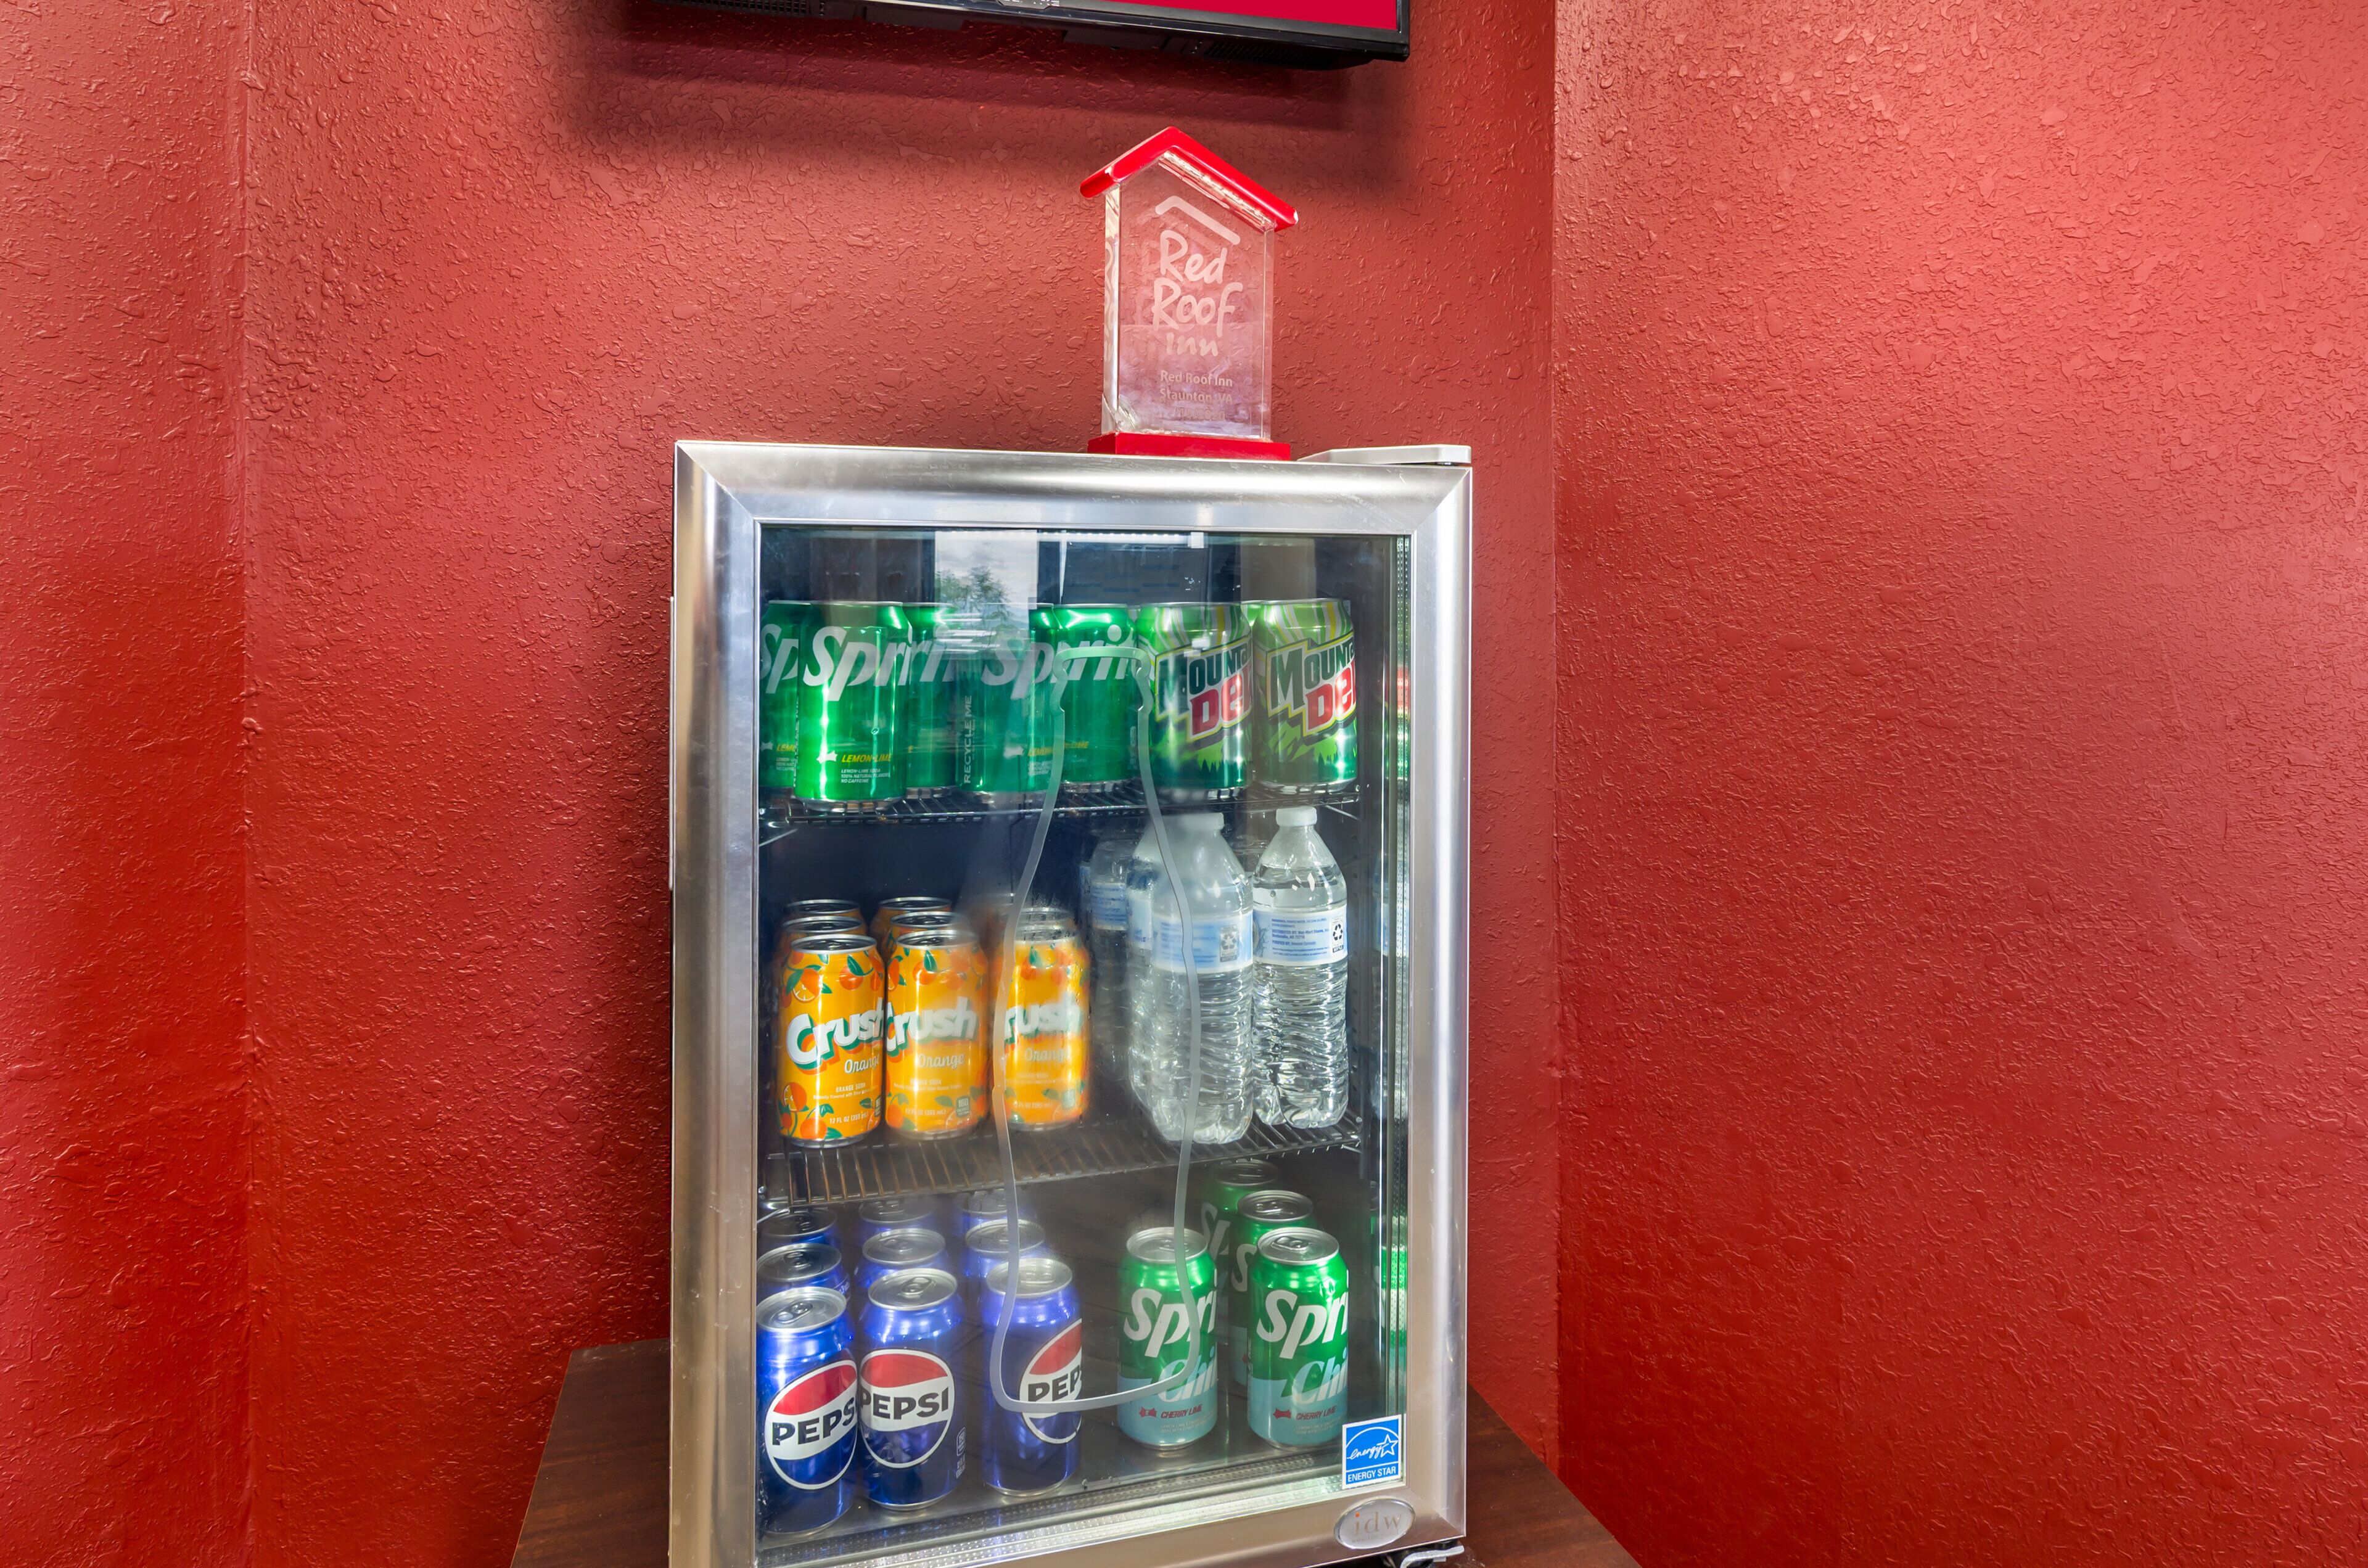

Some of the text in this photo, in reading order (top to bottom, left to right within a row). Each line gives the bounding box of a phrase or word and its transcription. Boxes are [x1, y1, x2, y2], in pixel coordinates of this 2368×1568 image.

[1160, 229, 1228, 284] Red
[1151, 277, 1243, 338] Roof
[1160, 370, 1233, 387] Red Roof Inn
[964, 696, 972, 784] RECYCLE ME
[842, 754, 892, 763] LEMON-LIME
[917, 1053, 965, 1070] Orange
[1028, 1365, 1082, 1402] PEP
[860, 1384, 949, 1420] PEPSI
[1161, 1404, 1202, 1419] CHERRY LIME
[772, 1396, 857, 1446] PEPS
[1296, 1410, 1323, 1421] CHERRY
[1347, 1446, 1385, 1459] energy
[1348, 1466, 1397, 1482] ENERGY STAR
[1354, 1511, 1402, 1536] idw
